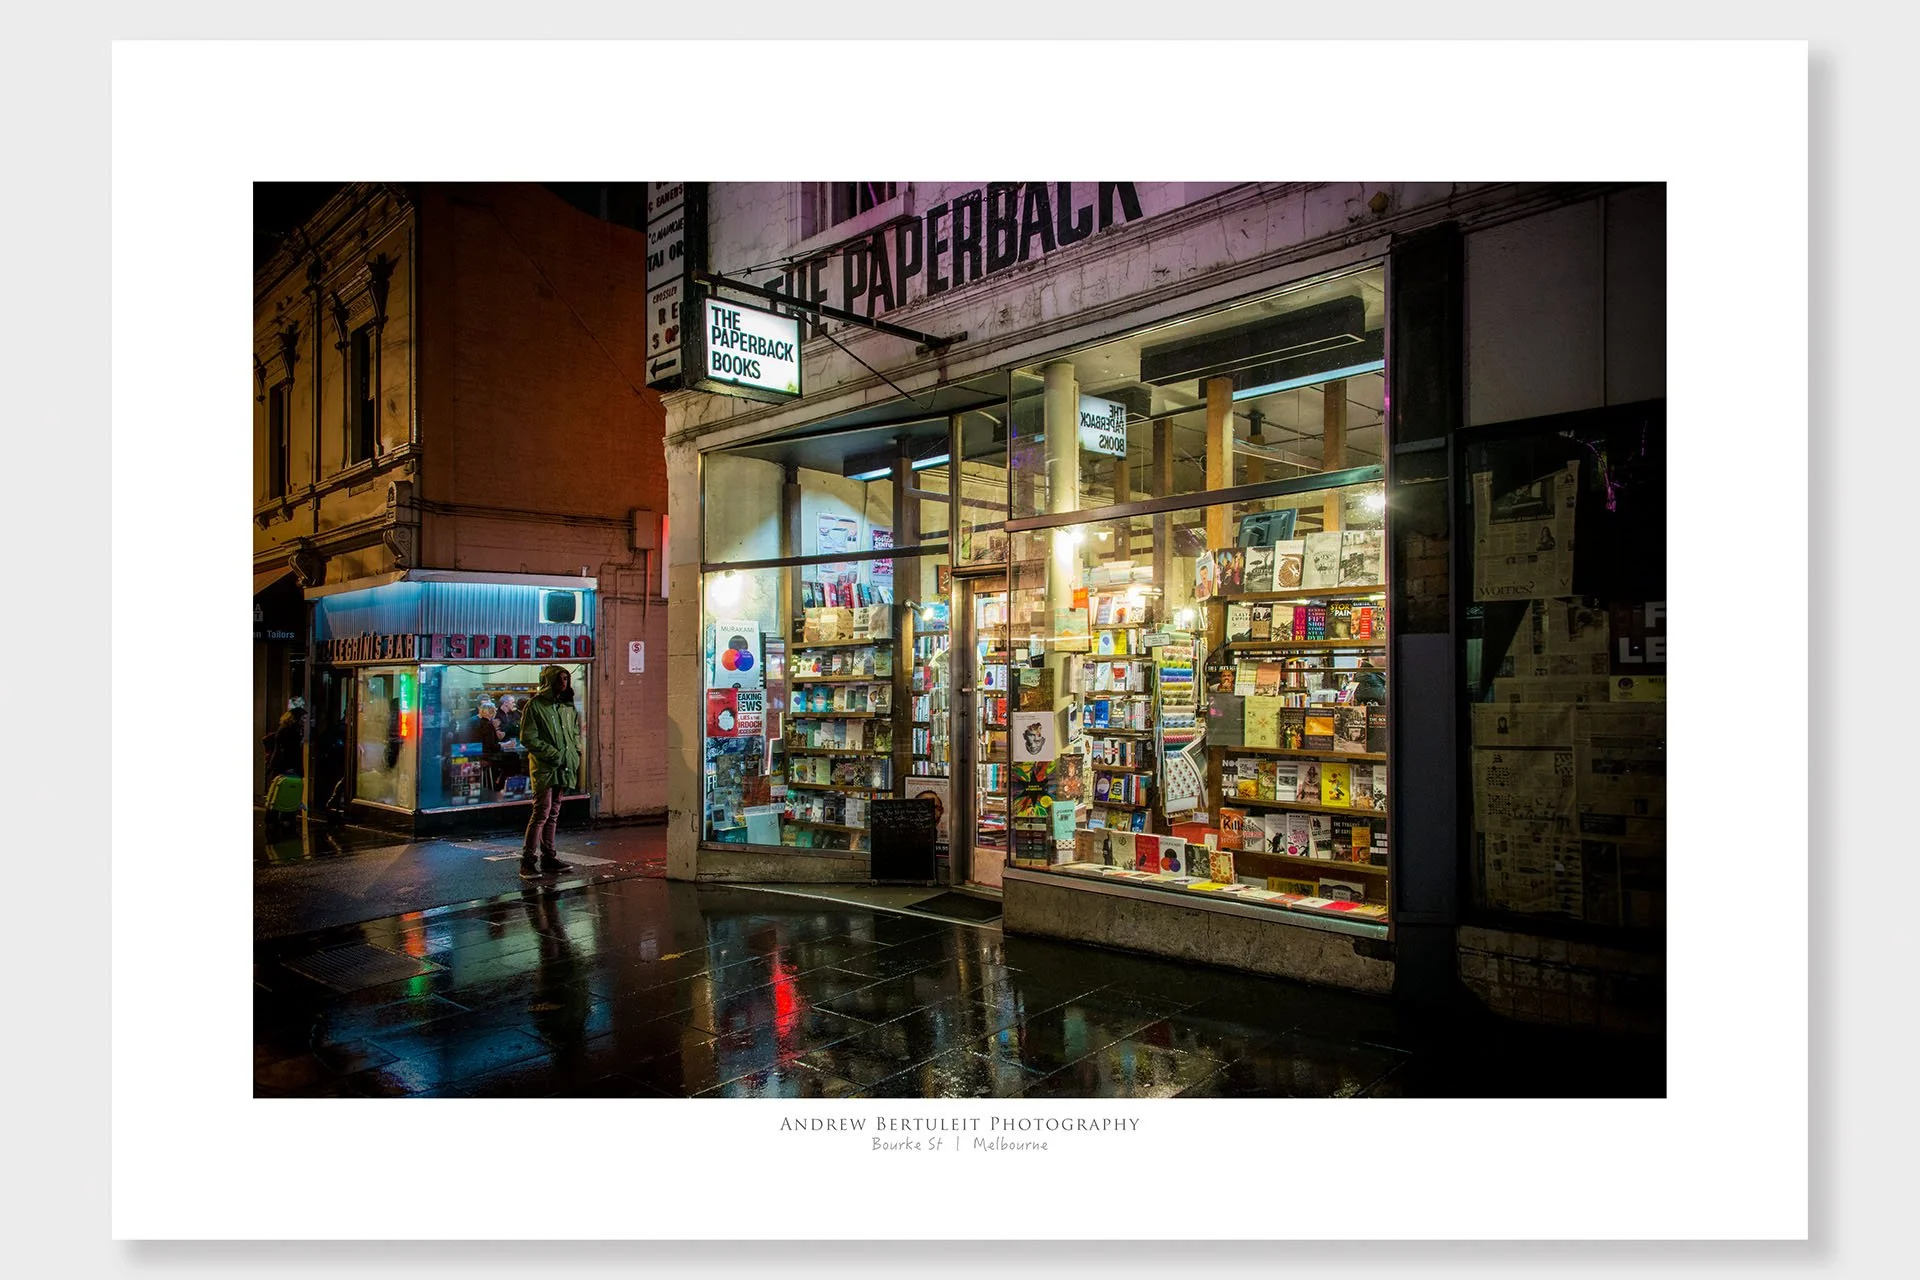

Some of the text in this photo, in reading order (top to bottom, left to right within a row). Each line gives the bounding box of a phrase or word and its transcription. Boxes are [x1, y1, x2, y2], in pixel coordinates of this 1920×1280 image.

[842, 182, 1144, 318] PAPERBACK
[711, 306, 741, 331] THE
[711, 325, 794, 362] PAPERBACK
[712, 351, 761, 379] BOOKS
[386, 634, 413, 659] BAR
[431, 634, 592, 659] ESPRESSO
